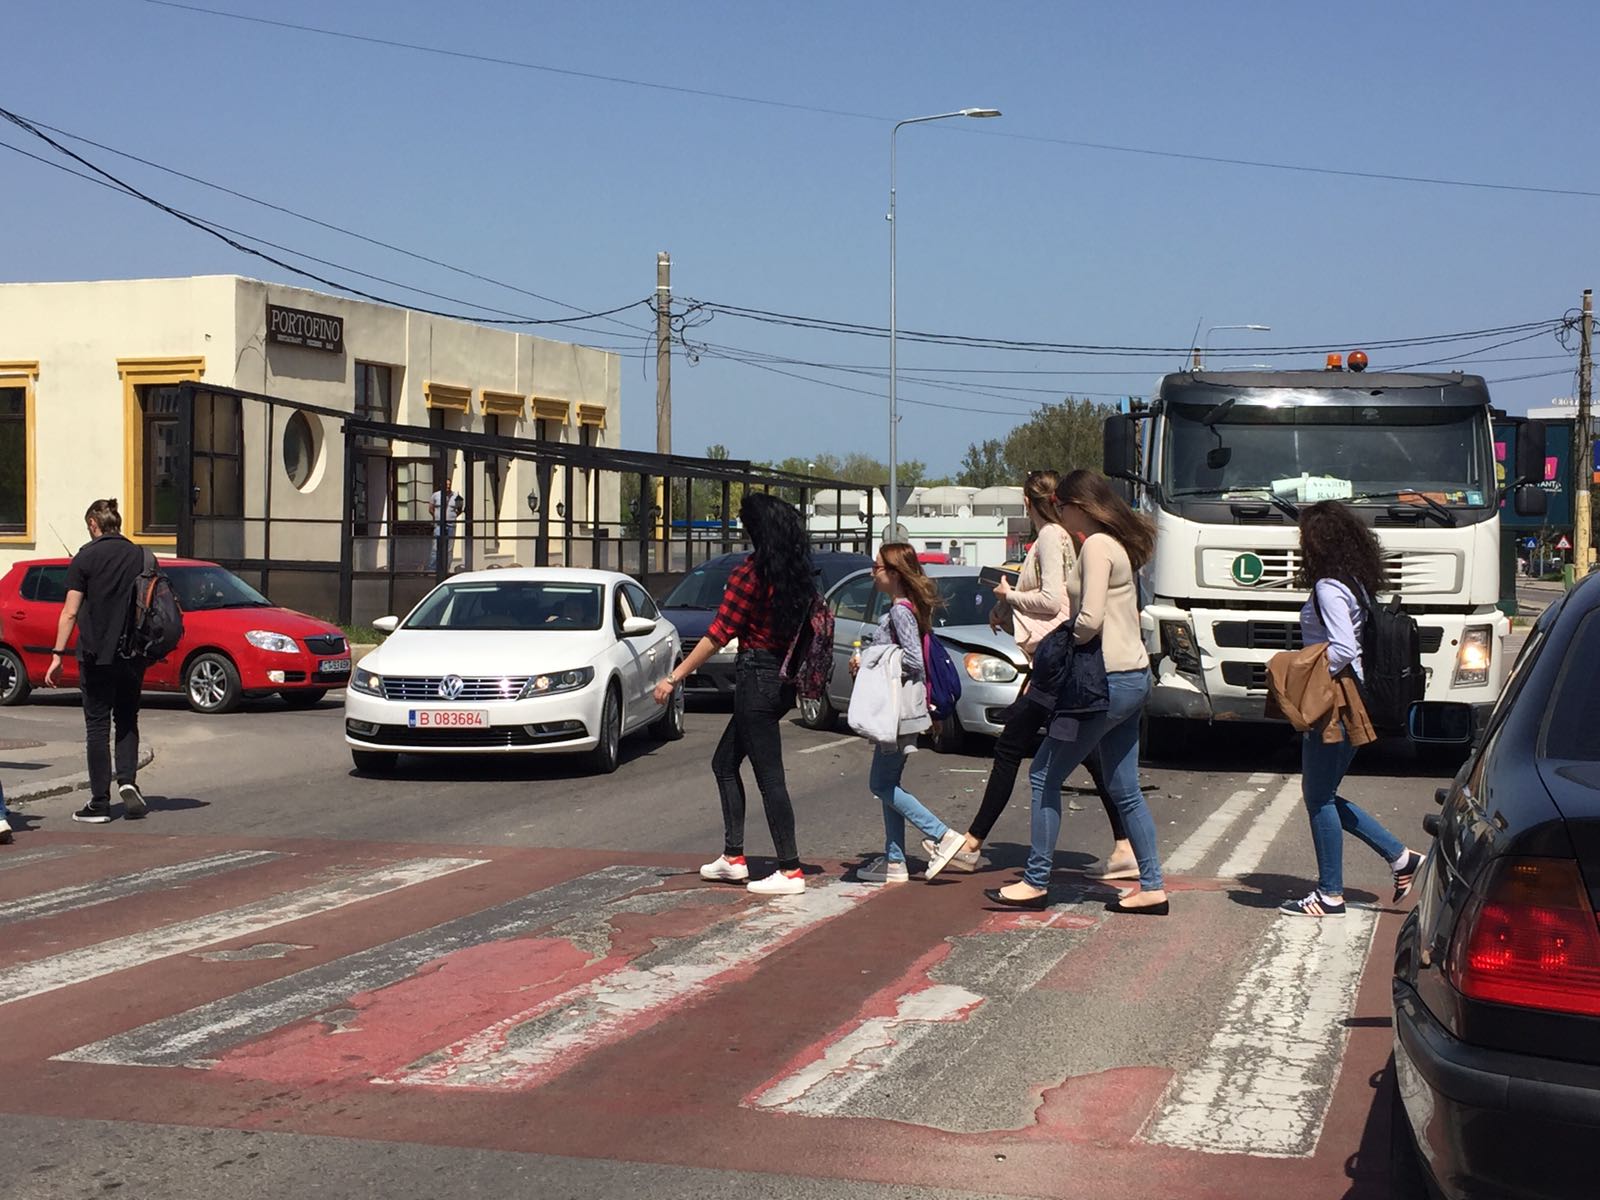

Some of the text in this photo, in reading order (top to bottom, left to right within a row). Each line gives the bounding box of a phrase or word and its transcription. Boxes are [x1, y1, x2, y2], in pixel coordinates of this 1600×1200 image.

[271, 309, 340, 341] PORTOFINO
[1240, 558, 1254, 579] L
[420, 712, 482, 726] B 083684
